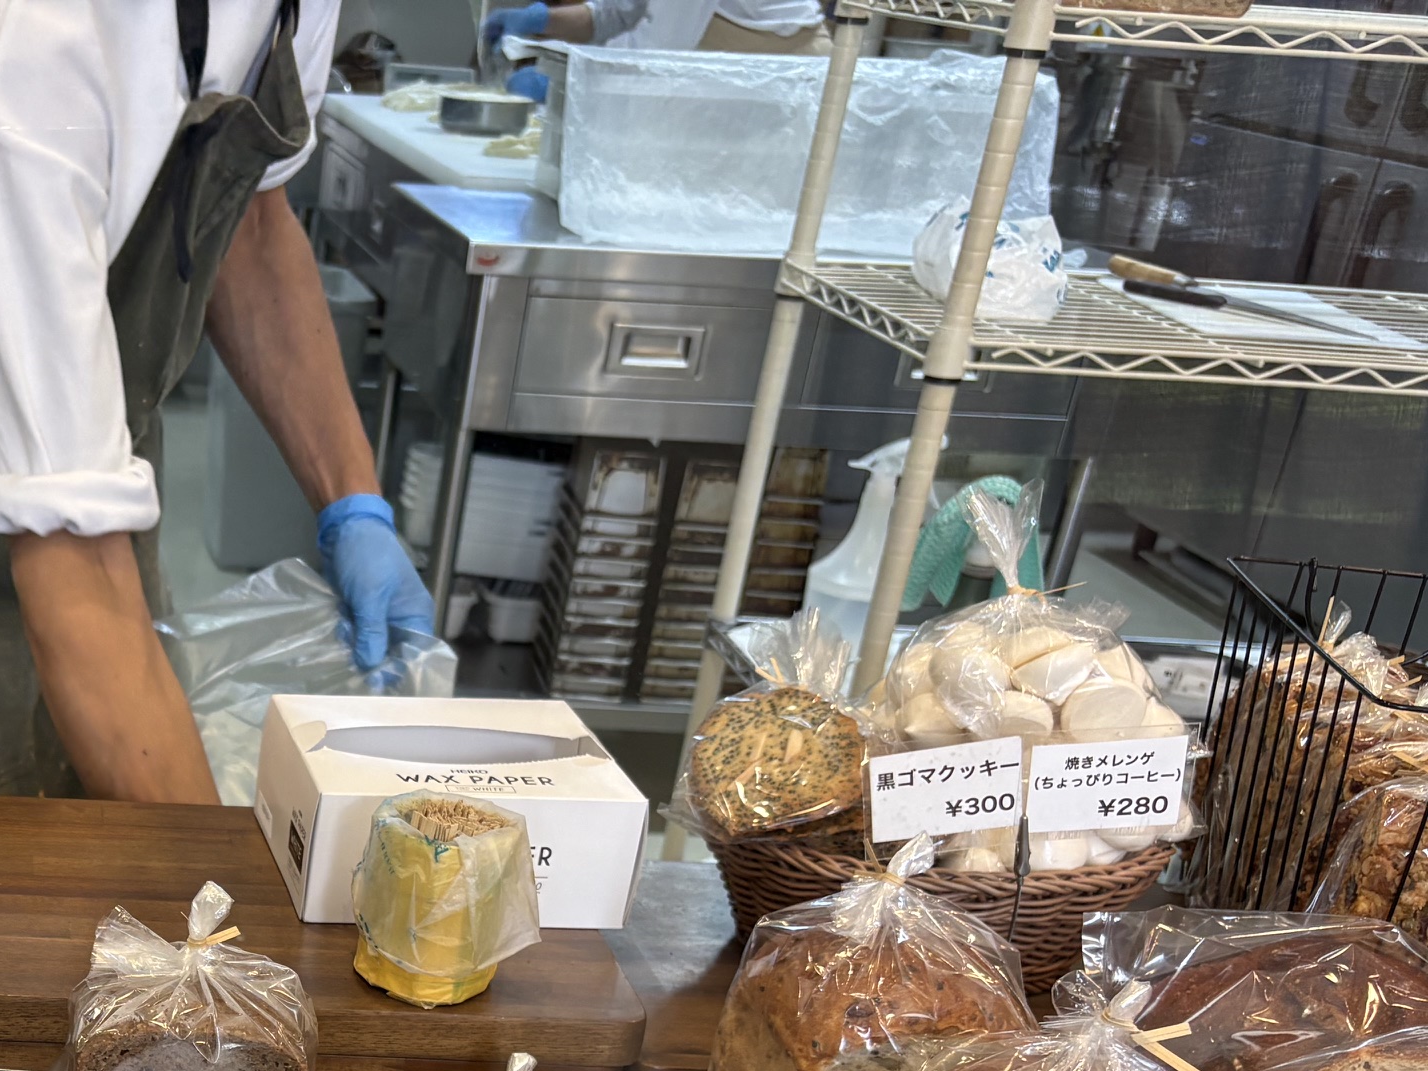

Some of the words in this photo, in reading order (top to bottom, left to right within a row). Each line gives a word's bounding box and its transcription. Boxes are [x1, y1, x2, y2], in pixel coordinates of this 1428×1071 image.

[1064, 751, 1155, 771] 焼きメレンゲ
[396, 773, 460, 784] WAX
[469, 775, 555, 786] PAPER
[876, 758, 1020, 791] 黒ゴマクッキー
[945, 793, 1015, 818] ¥300
[1097, 795, 1169, 817] ¥280
